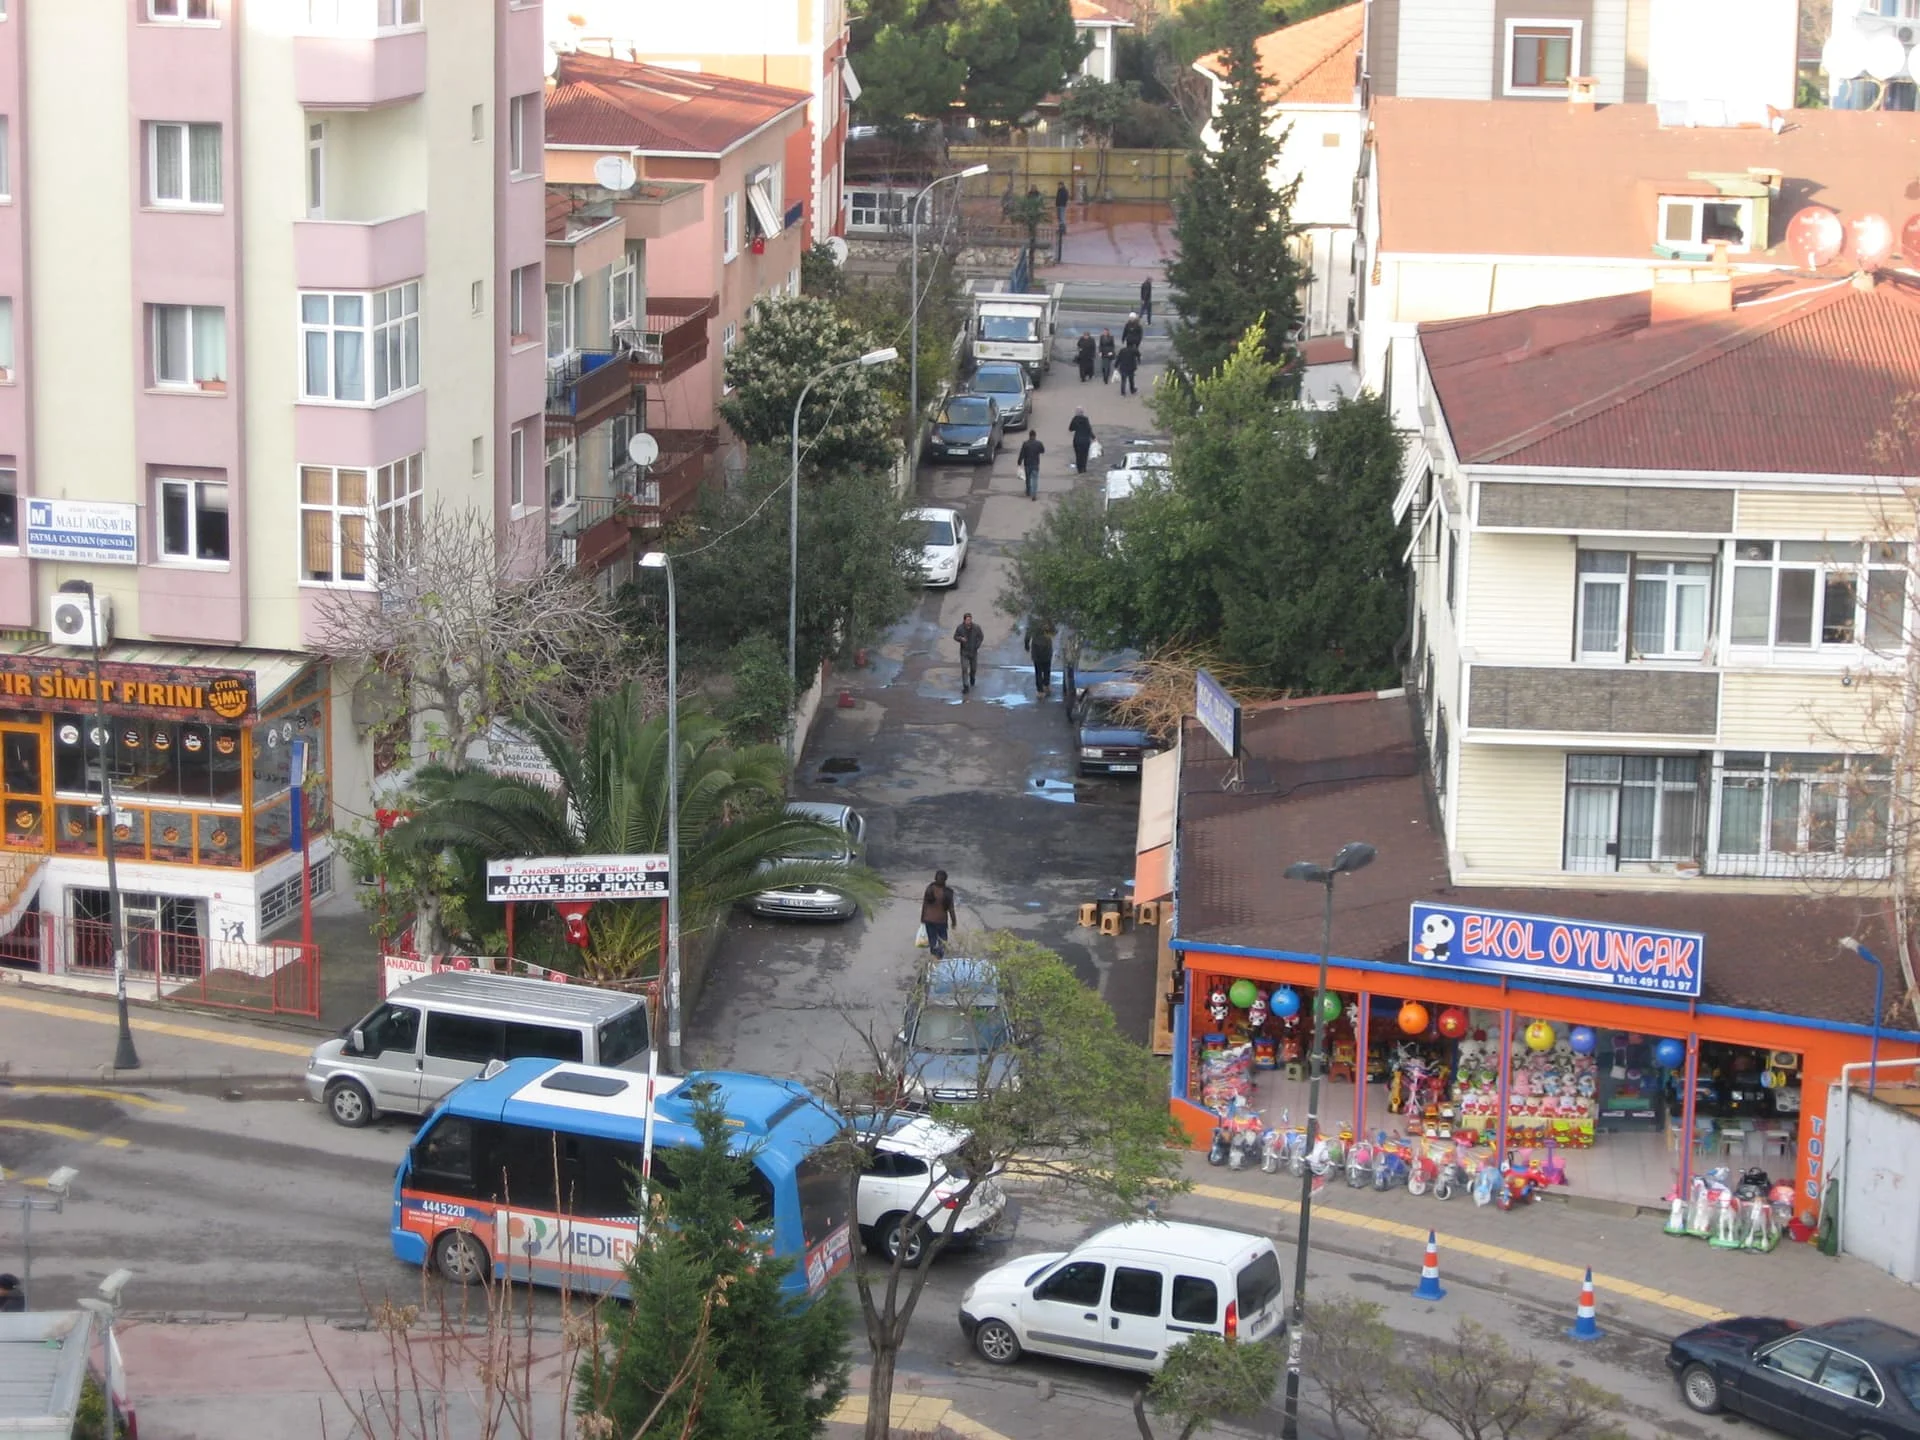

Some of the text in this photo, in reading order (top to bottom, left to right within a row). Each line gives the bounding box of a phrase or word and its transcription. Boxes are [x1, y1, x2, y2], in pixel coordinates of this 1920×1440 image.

[30, 533, 58, 543] FATMA
[59, 536, 96, 545] CANDAN
[0, 668, 203, 709] IR SİMİT FIRINI
[208, 690, 249, 707] SİMİT
[509, 875, 552, 885] BOKS
[604, 872, 647, 882] BOKS
[521, 865, 640, 875] ANADOLU KAPLANLARI
[494, 884, 587, 895] KARATE-DO
[1462, 915, 1694, 978] EKOL OYUNCAK
[386, 958, 427, 974] ANADOLU
[1617, 974, 1692, 991] Tel: 491 03 97
[1805, 1115, 1823, 1199] TOYS
[422, 1200, 465, 1217] 4445220
